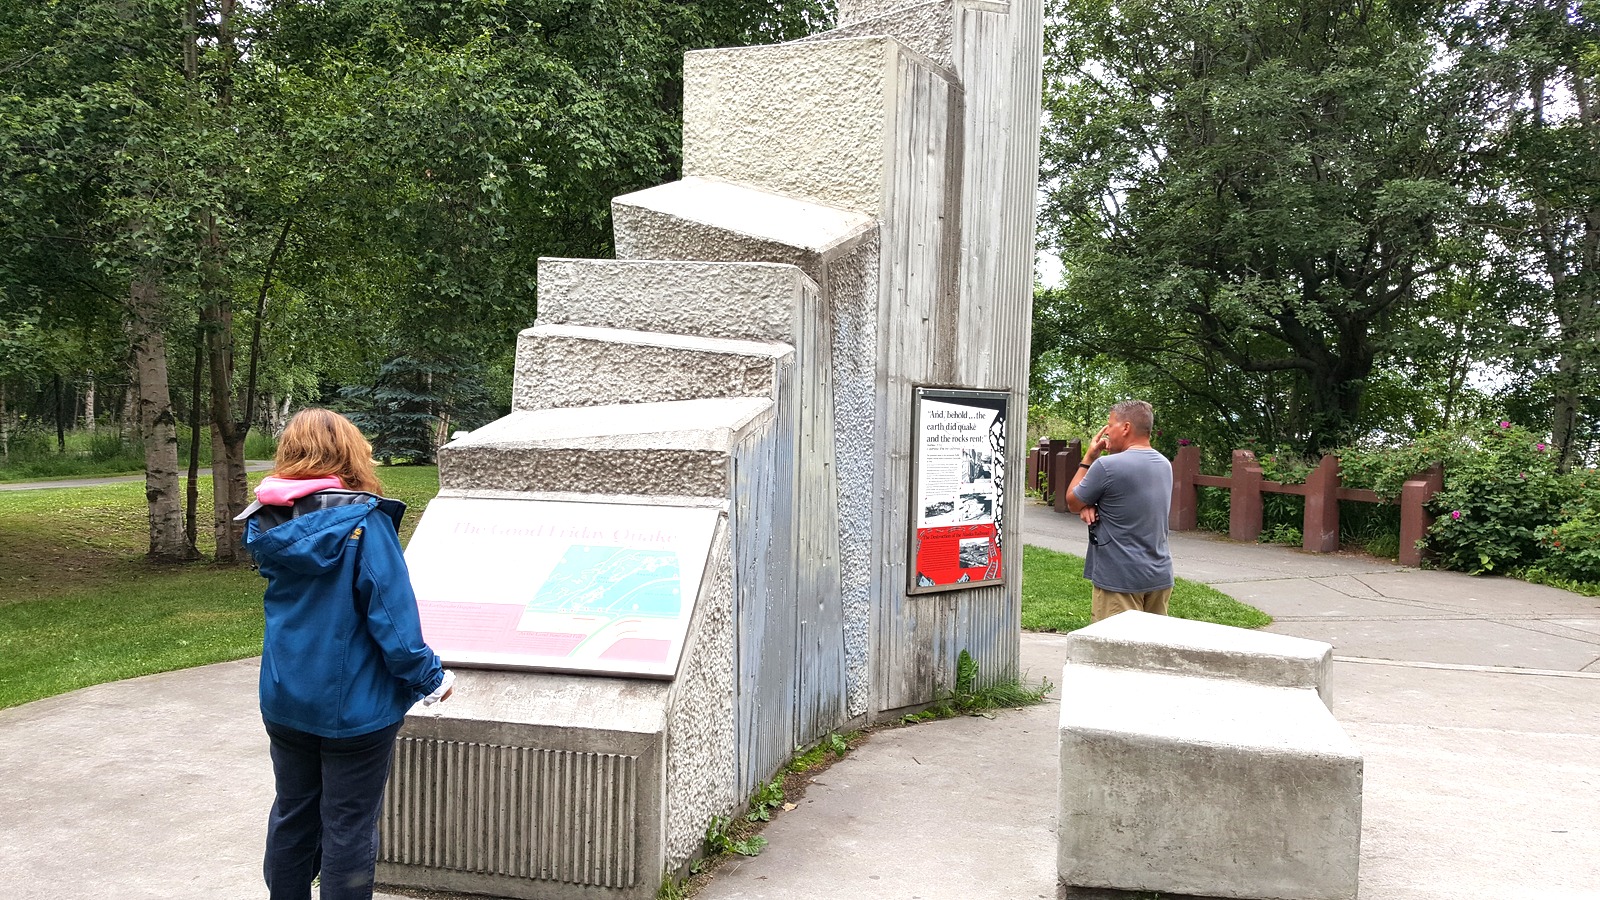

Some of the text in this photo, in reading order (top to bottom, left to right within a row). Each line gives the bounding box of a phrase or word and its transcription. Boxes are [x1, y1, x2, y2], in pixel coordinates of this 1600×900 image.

[958, 423, 976, 433] quake
[490, 524, 544, 536] Good
[612, 528, 677, 543] Quake
